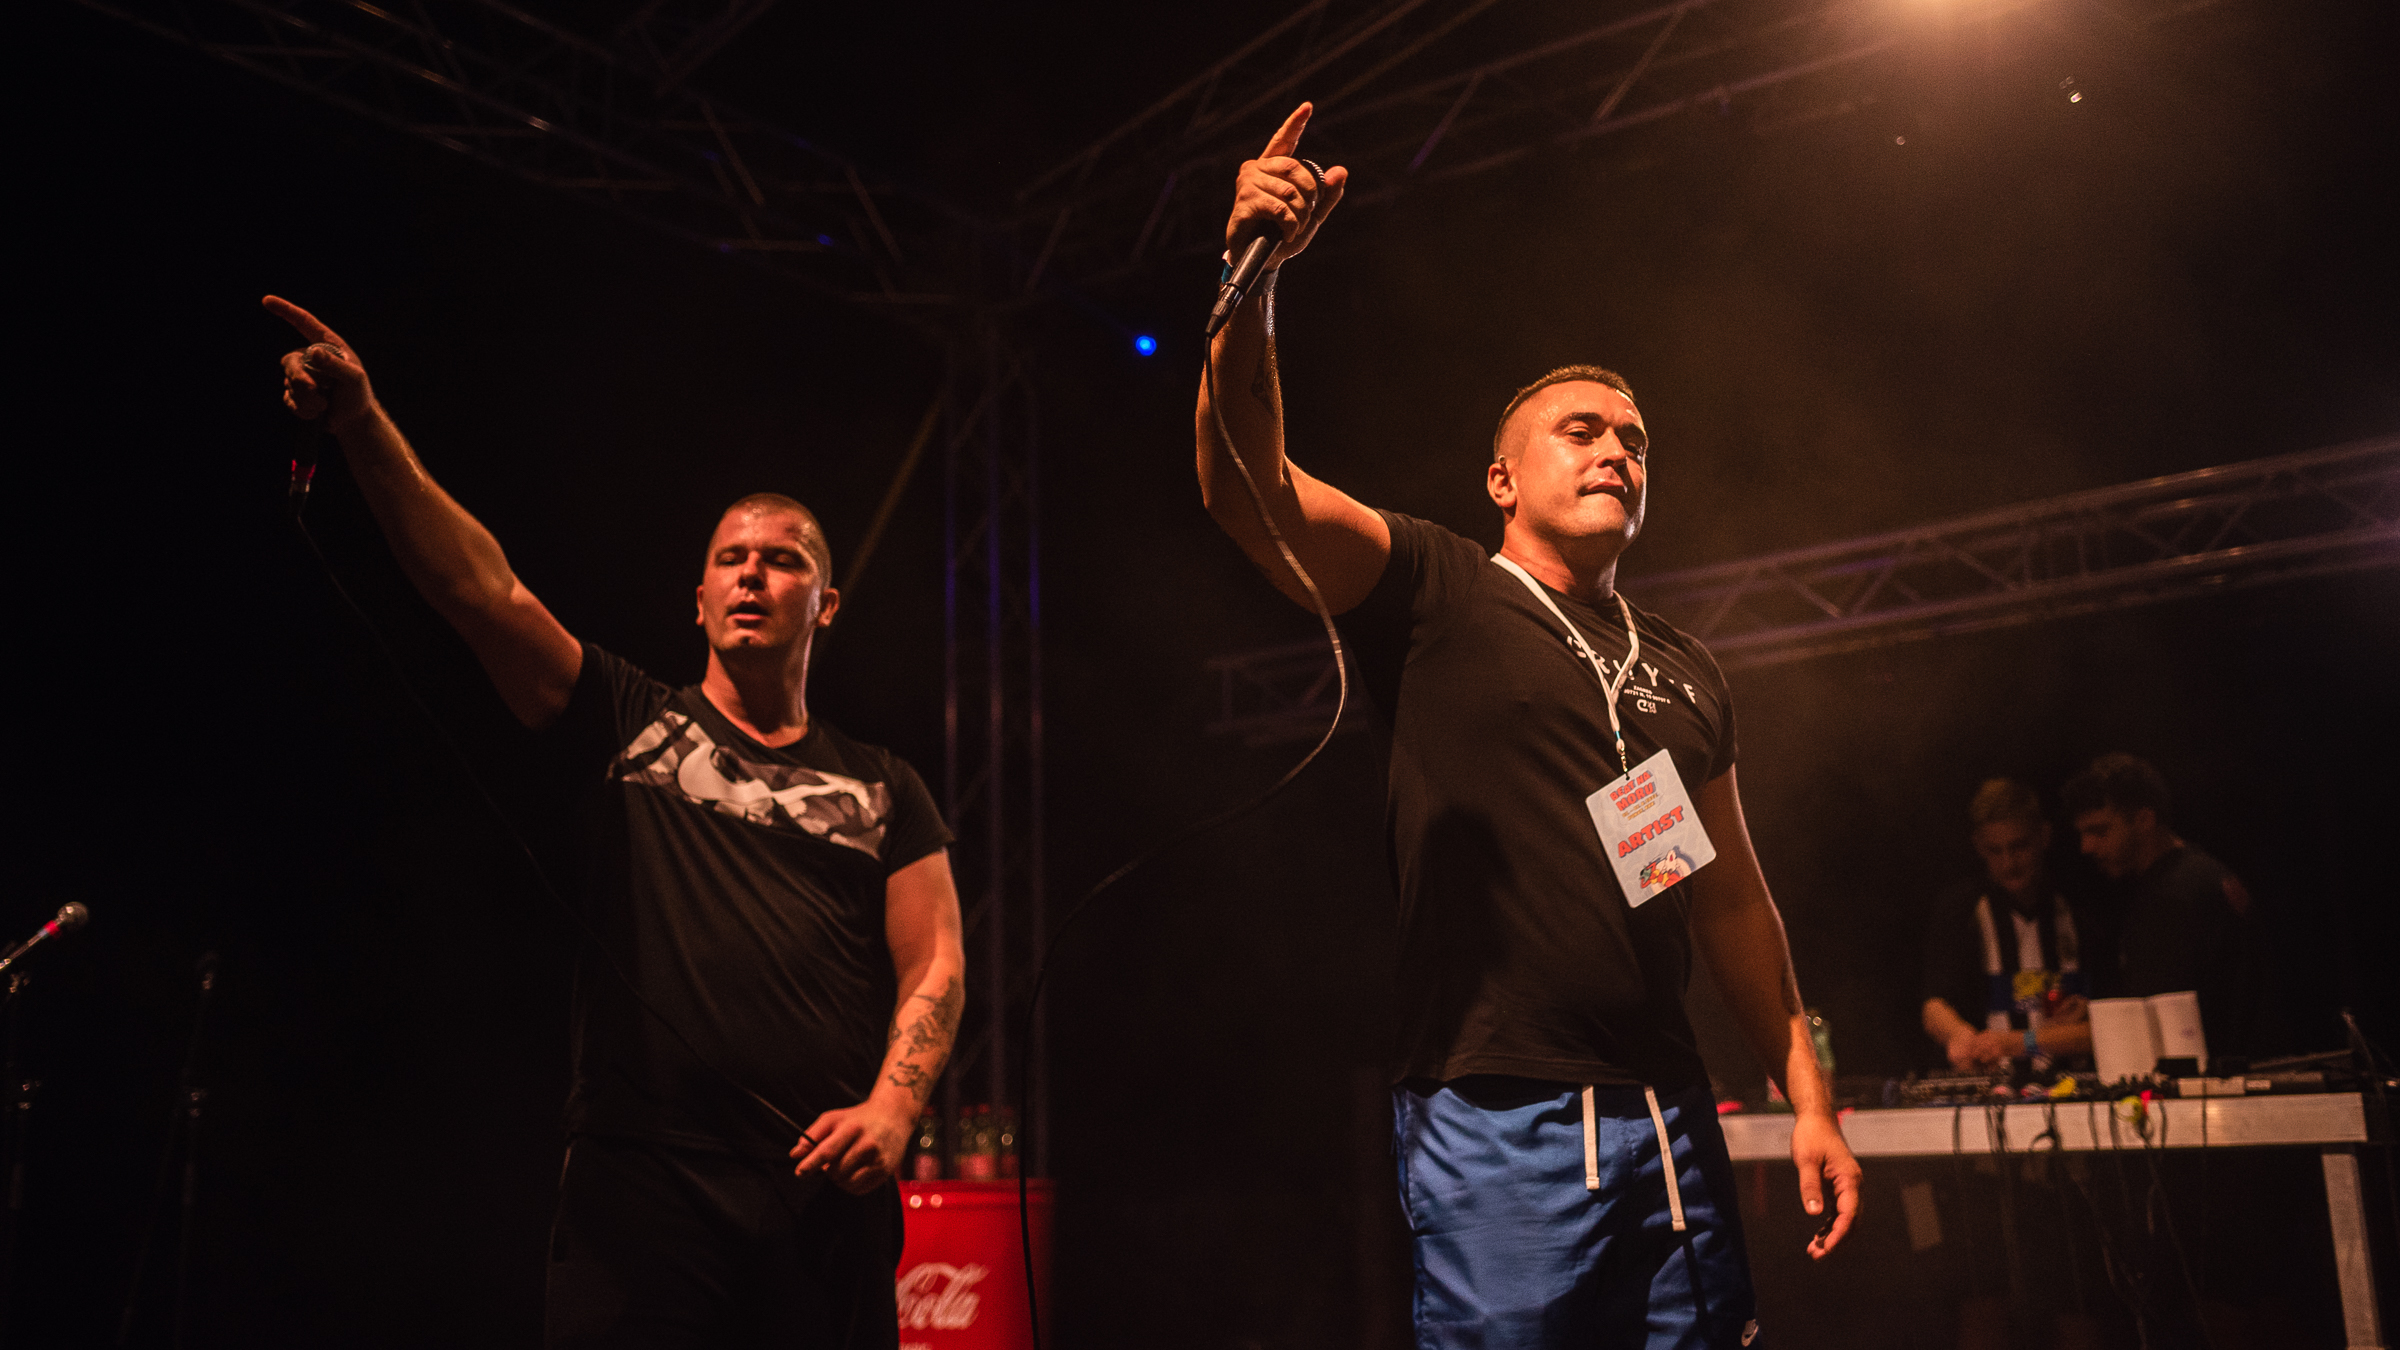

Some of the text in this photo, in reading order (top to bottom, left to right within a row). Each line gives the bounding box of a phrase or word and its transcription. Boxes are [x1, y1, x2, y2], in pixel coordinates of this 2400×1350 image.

[1610, 770, 1653, 801] BEAT NA
[1616, 781, 1656, 811] MORU
[1618, 805, 1684, 858] ARTIST
